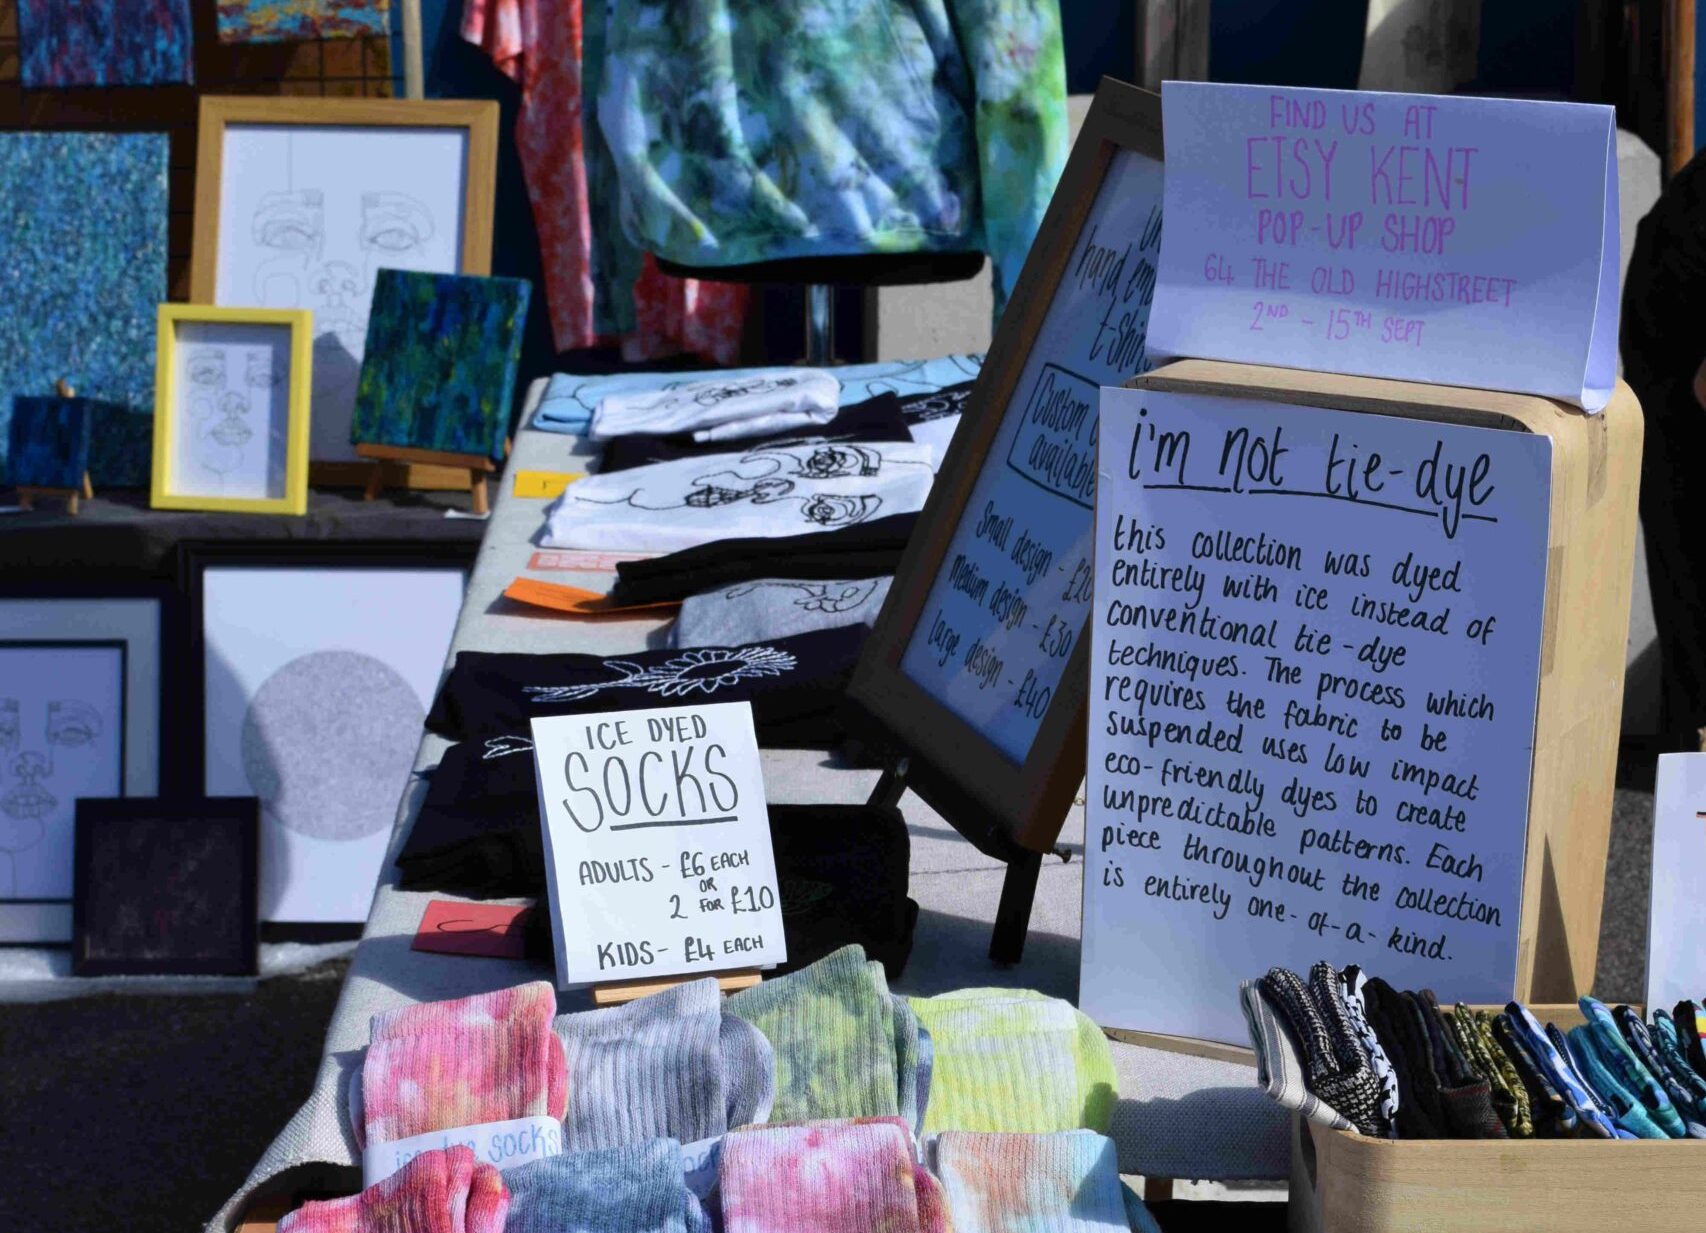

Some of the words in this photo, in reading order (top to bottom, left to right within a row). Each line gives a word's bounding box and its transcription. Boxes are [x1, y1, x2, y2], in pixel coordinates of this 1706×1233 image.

[1271, 95, 1326, 131] FIND
[1342, 103, 1375, 135] US
[1404, 105, 1437, 139] AT
[1247, 137, 1337, 201] ETSY
[1371, 145, 1479, 210] KENT
[1257, 209, 1363, 249] POP-UP
[1382, 214, 1456, 254] SHOP
[1205, 253, 1234, 284] 64
[1252, 257, 1290, 290] THE
[1311, 265, 1354, 295] OLD
[1376, 269, 1516, 306] HIGHSTREET
[1250, 301, 1289, 331] 2ND
[1327, 309, 1372, 341] 15TH
[1384, 319, 1425, 346] SEPT
[1129, 409, 1189, 484] i'm
[1219, 427, 1288, 492] not
[1326, 434, 1494, 539] tie-dye
[1011, 530, 1052, 586] design
[1114, 516, 1165, 551] this
[1192, 531, 1301, 570] collection
[1325, 551, 1371, 577] was
[1393, 552, 1461, 602] dyed
[989, 580, 1027, 630] design
[1039, 614, 1072, 658] £30
[1107, 600, 1277, 648] conventional
[1113, 559, 1203, 608] entirely
[1224, 575, 1277, 602] with
[1296, 584, 1328, 610] ice
[1353, 594, 1449, 635] instead
[1467, 617, 1495, 644] of
[965, 638, 1003, 690] design
[1014, 668, 1050, 719] £40
[1109, 641, 1246, 680] techniques.
[1266, 657, 1301, 684] The
[1317, 673, 1404, 709] process
[1427, 692, 1494, 721] which
[586, 721, 633, 749] ICE
[648, 714, 706, 743] DYED
[1104, 674, 1206, 711] requires
[1227, 690, 1265, 719] the
[1284, 699, 1357, 739] fabric
[1381, 718, 1401, 741] to
[1421, 725, 1446, 753] be
[1106, 711, 1243, 754] suspended
[1263, 736, 1308, 763] uses
[1325, 744, 1370, 777] low
[1392, 759, 1479, 800] impact
[563, 744, 738, 832] SOCKS
[1282, 777, 1337, 817] dyes
[1356, 789, 1377, 817] to
[1397, 802, 1465, 832] create
[1103, 785, 1276, 837] unpredictable
[1300, 826, 1410, 864] patterns.
[1426, 843, 1483, 882] Each
[579, 858, 654, 885] ADULTS
[680, 851, 705, 878] £6
[711, 850, 749, 871] EACH
[700, 877, 717, 892] OR
[1102, 825, 1161, 852] piece
[1184, 835, 1325, 891] throughout
[1342, 873, 1380, 901] the
[1396, 885, 1501, 927] collection
[1104, 861, 1124, 887] is
[1144, 874, 1231, 919] entirely
[669, 895, 688, 919] 2
[700, 899, 725, 912] FOR
[731, 886, 774, 914] £10
[685, 937, 714, 962] £4
[724, 935, 763, 954] EACH
[488, 1124, 558, 1163] socks
